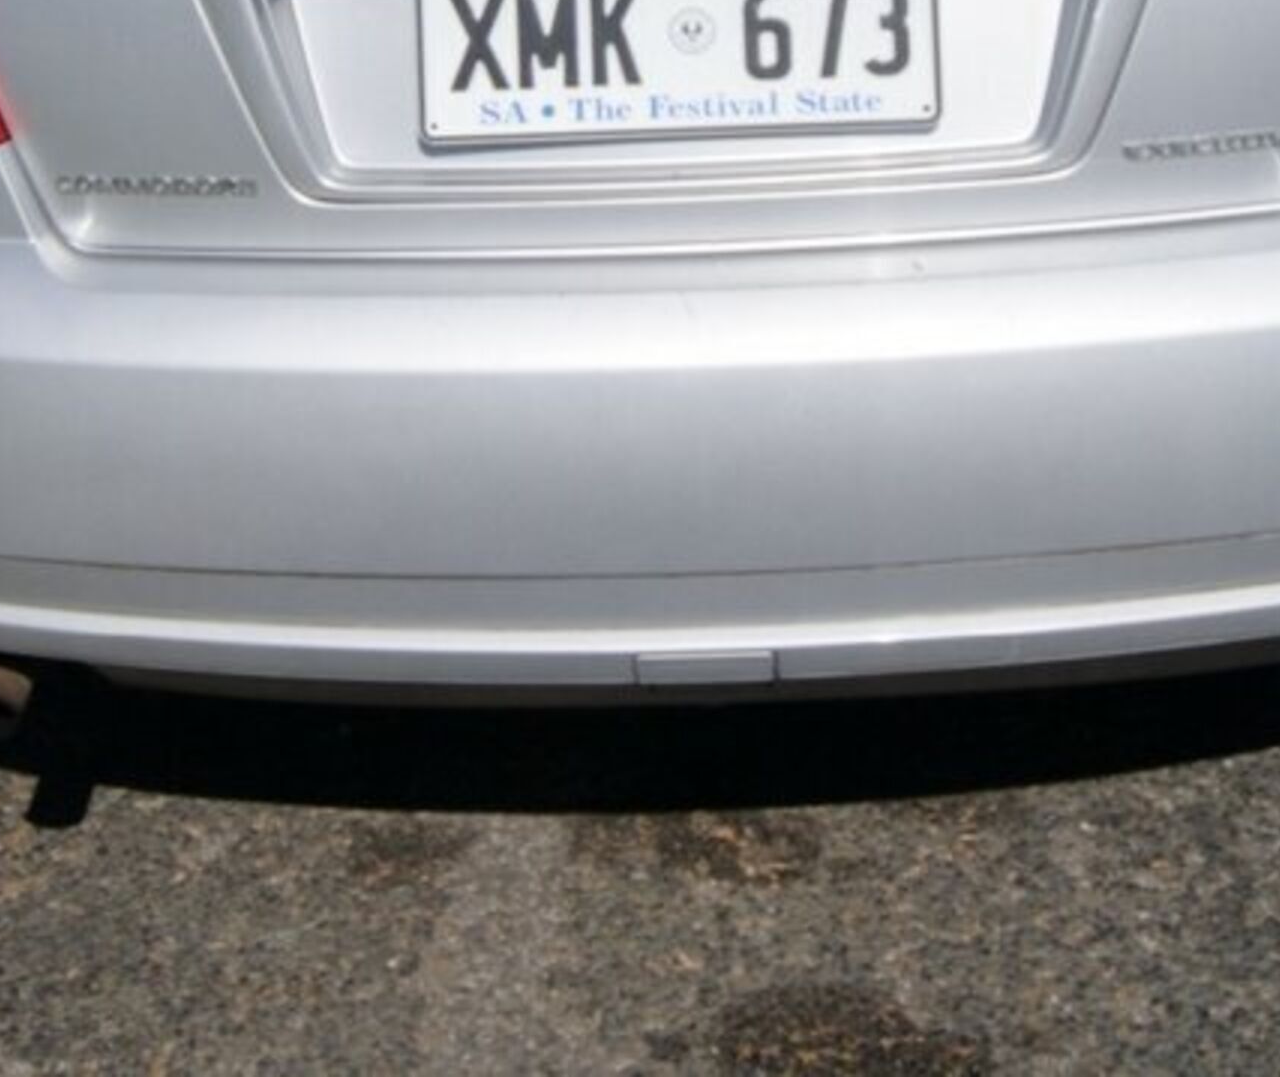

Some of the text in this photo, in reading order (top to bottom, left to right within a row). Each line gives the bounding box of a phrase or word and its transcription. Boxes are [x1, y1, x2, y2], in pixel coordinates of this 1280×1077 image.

[479, 90, 882, 125] SA The Festival State
